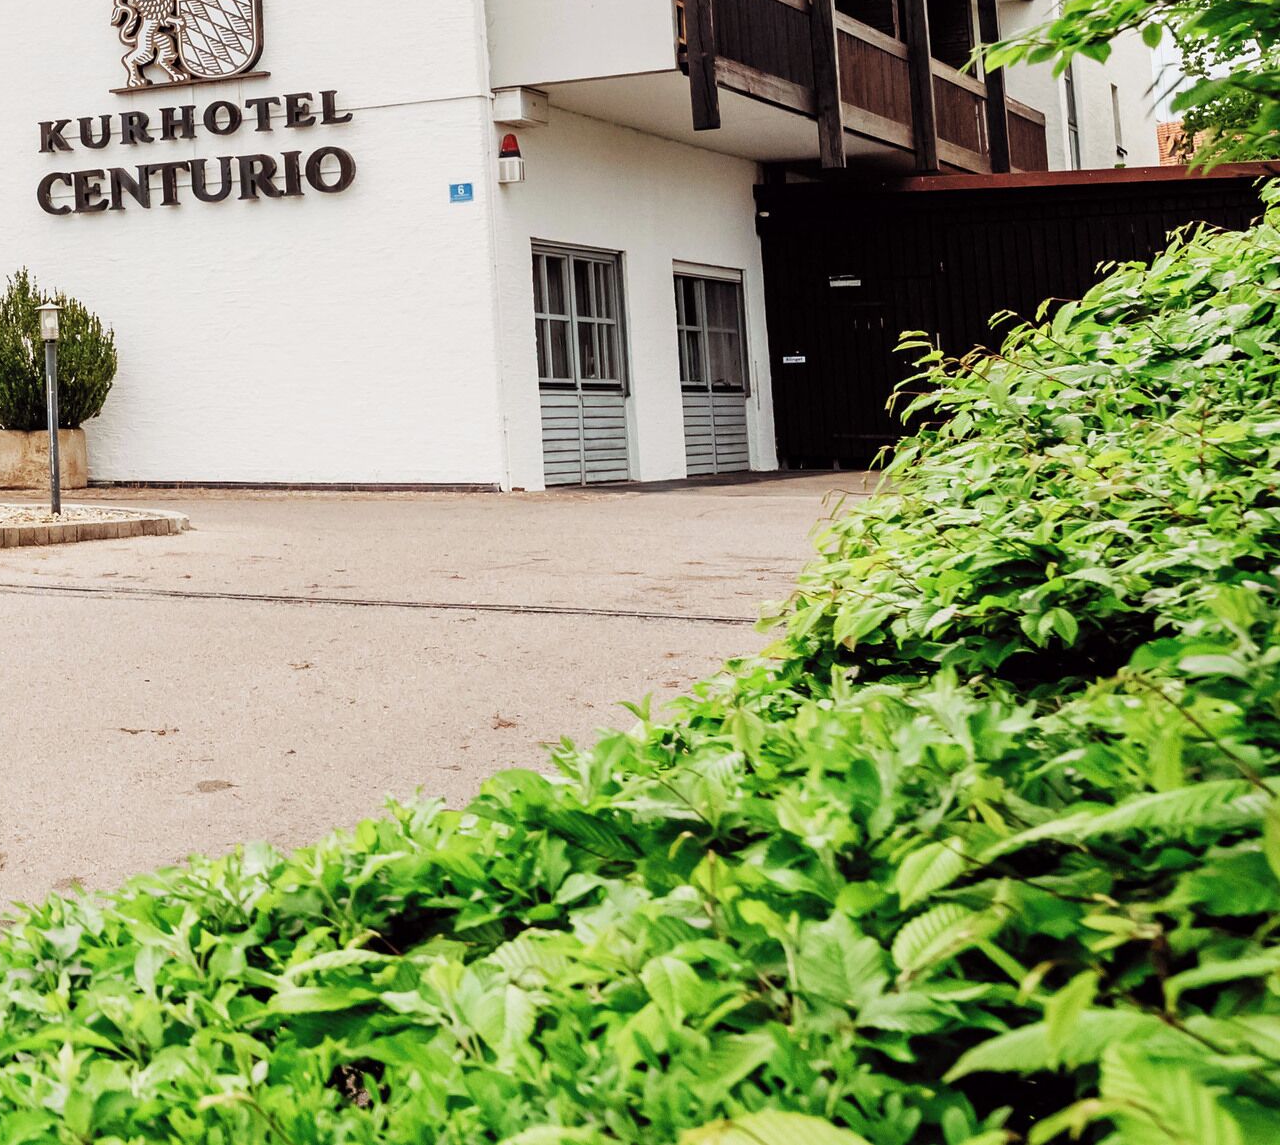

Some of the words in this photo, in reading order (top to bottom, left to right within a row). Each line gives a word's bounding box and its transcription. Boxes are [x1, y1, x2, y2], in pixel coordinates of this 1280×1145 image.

[38, 90, 353, 153] KURHOTEL
[37, 146, 357, 216] CENTURIO
[457, 184, 465, 195] 6
